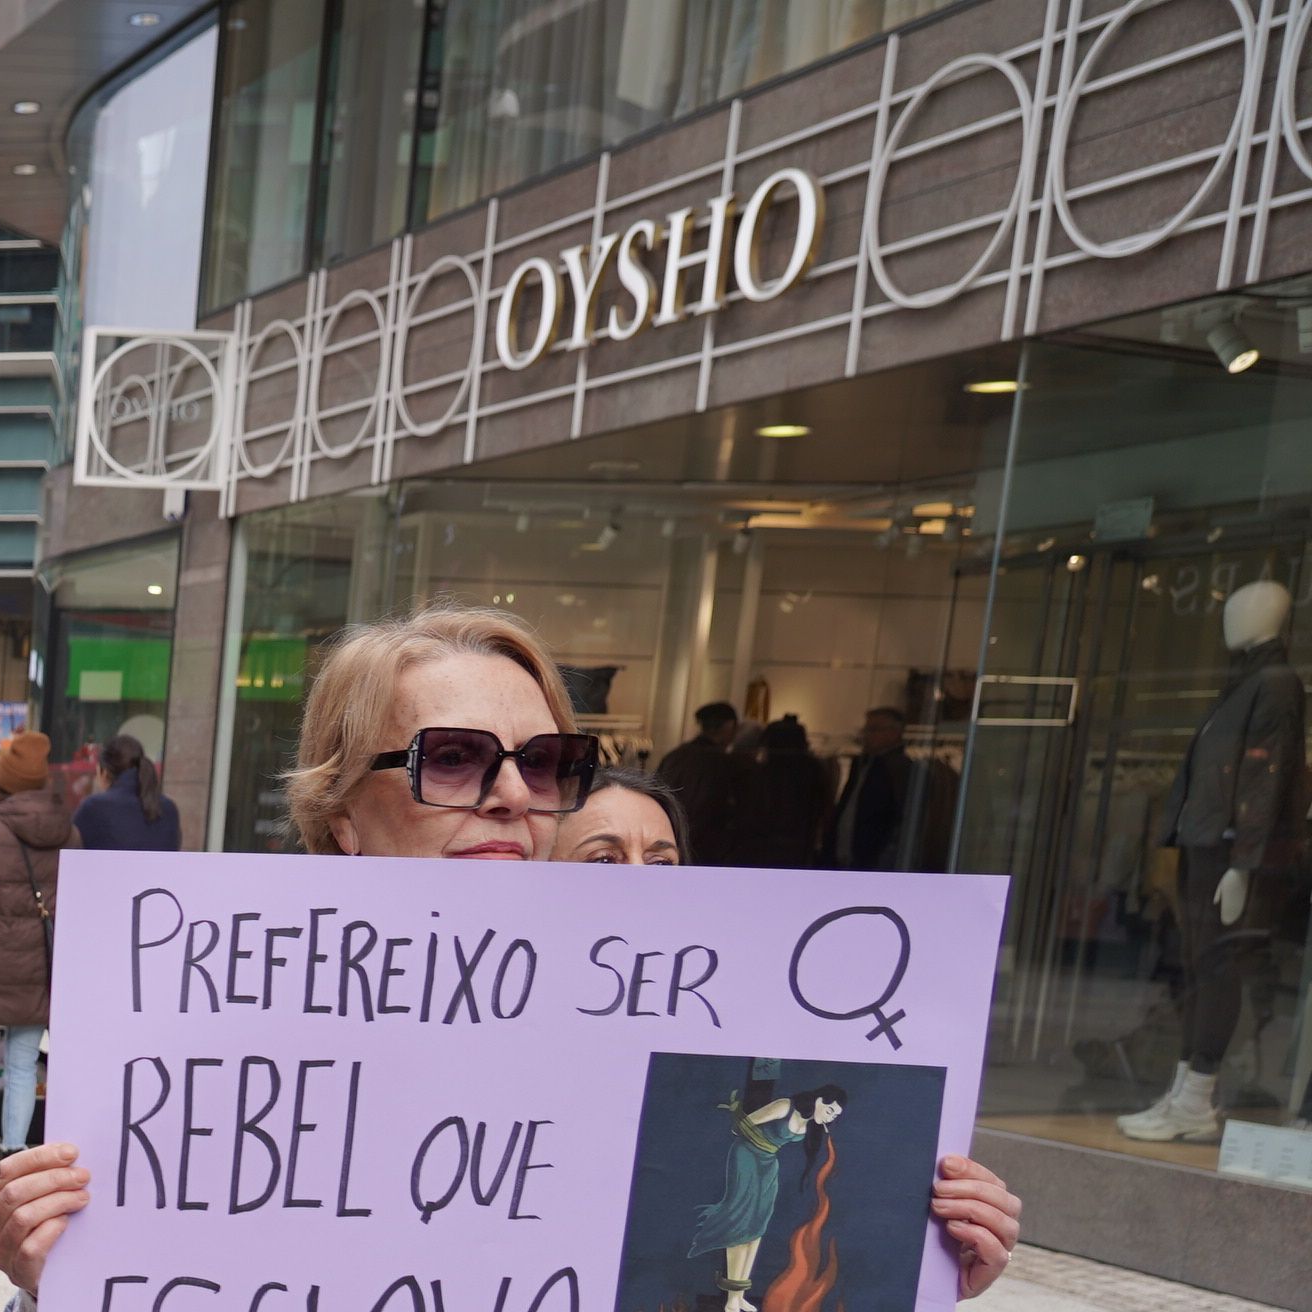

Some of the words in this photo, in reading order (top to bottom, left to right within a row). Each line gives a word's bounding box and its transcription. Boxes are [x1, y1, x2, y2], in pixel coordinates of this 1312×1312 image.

[495, 167, 826, 370] OYSHO
[576, 934, 723, 1028] SER
[115, 1055, 371, 1219] REBEL
[410, 1115, 554, 1224] QUE
